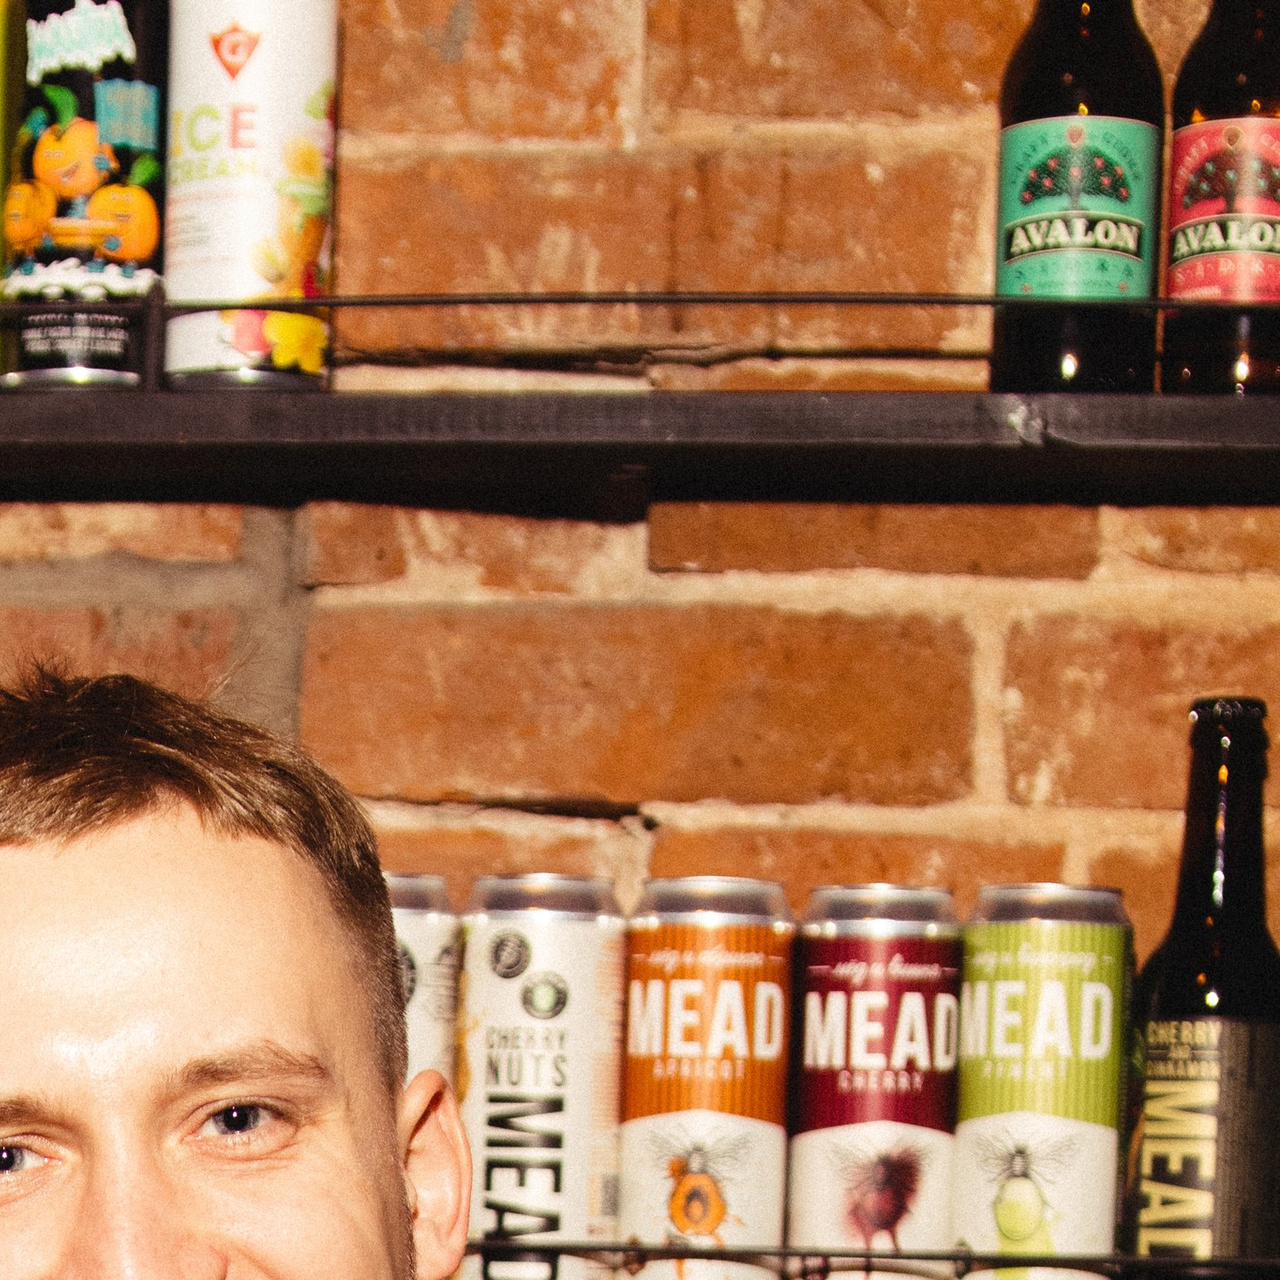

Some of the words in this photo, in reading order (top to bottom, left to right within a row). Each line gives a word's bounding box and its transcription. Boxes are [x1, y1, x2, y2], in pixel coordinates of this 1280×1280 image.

[170, 105, 257, 156] ICE
[1011, 218, 1139, 254] AVALON
[628, 978, 785, 1060] MEAD
[805, 990, 958, 1071] MEAD
[962, 980, 1113, 1059] MEAD
[1146, 1021, 1222, 1046] CHERRY
[487, 1026, 568, 1049] CHERRY
[486, 1053, 568, 1087] NUTS
[837, 1069, 925, 1093] CHERRY
